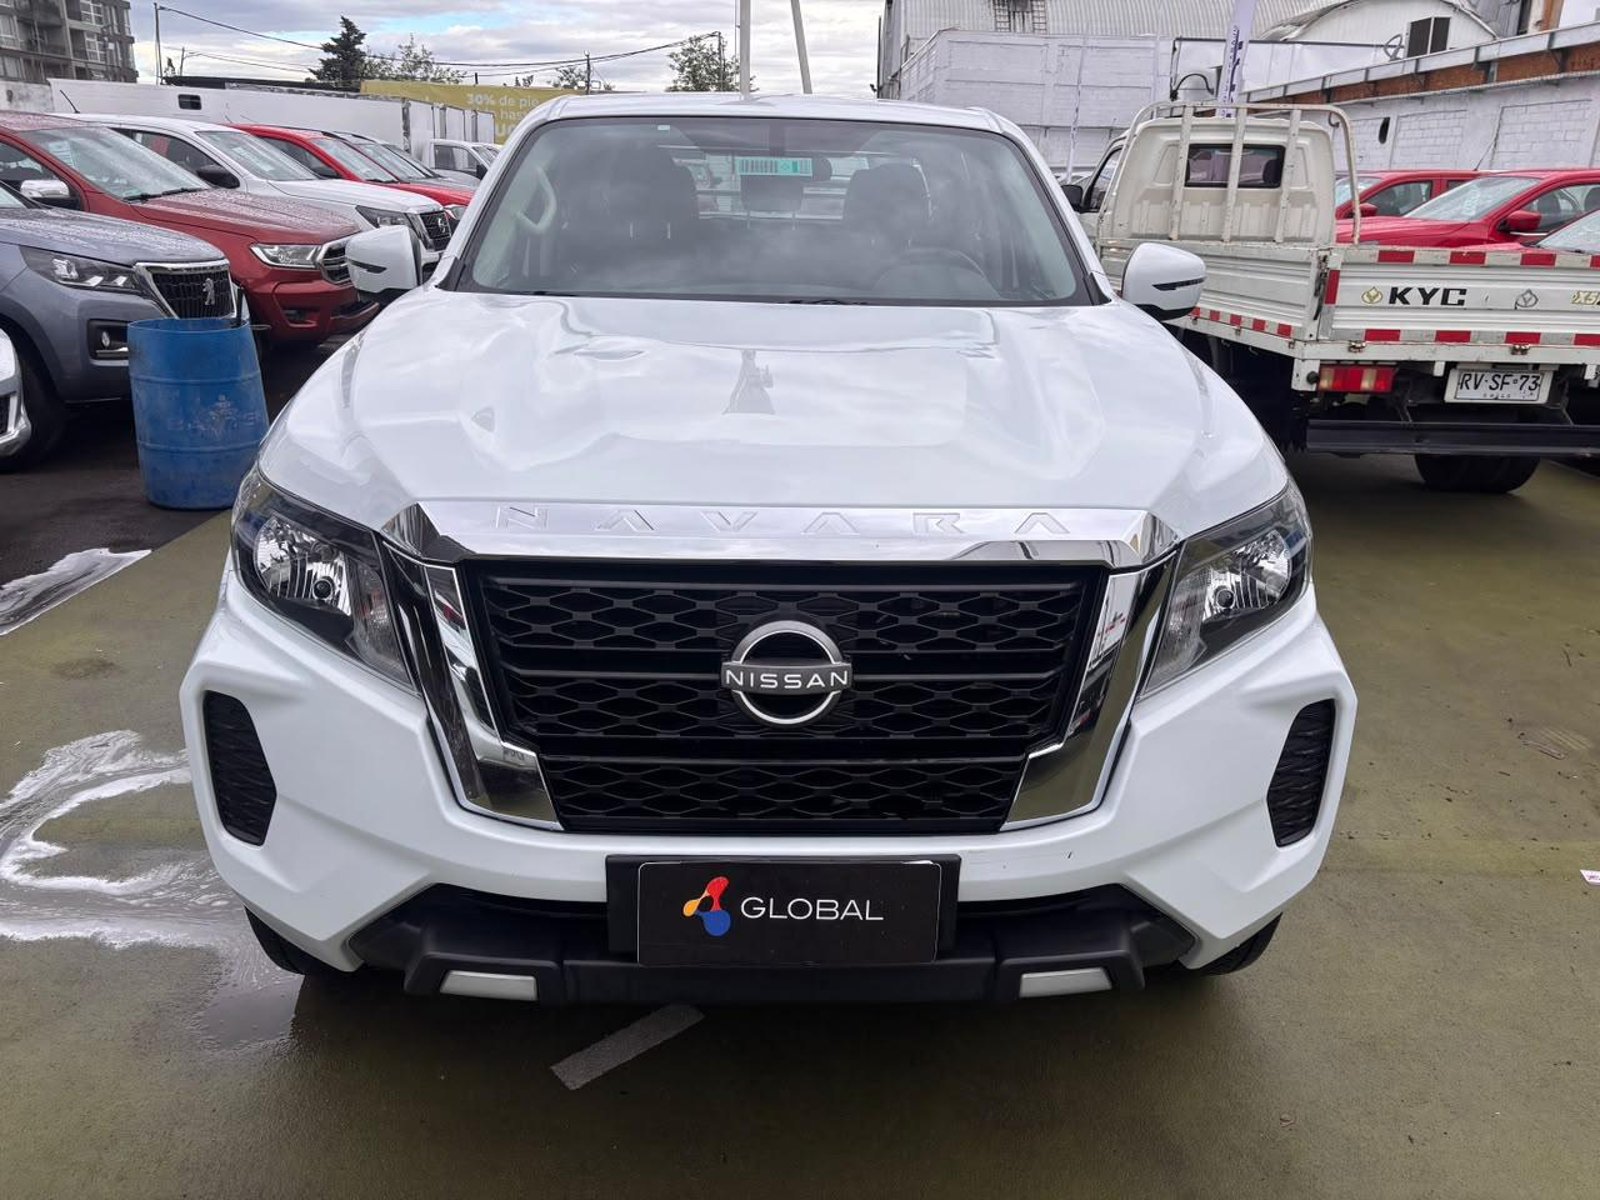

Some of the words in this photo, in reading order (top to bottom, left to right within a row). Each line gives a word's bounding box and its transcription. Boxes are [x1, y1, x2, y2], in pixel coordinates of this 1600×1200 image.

[499, 95, 516, 106] de
[1389, 287, 1467, 306] KYC
[496, 505, 1071, 535] NAVARA
[725, 669, 848, 689] NISSAN
[741, 897, 883, 921] GLOBAL
